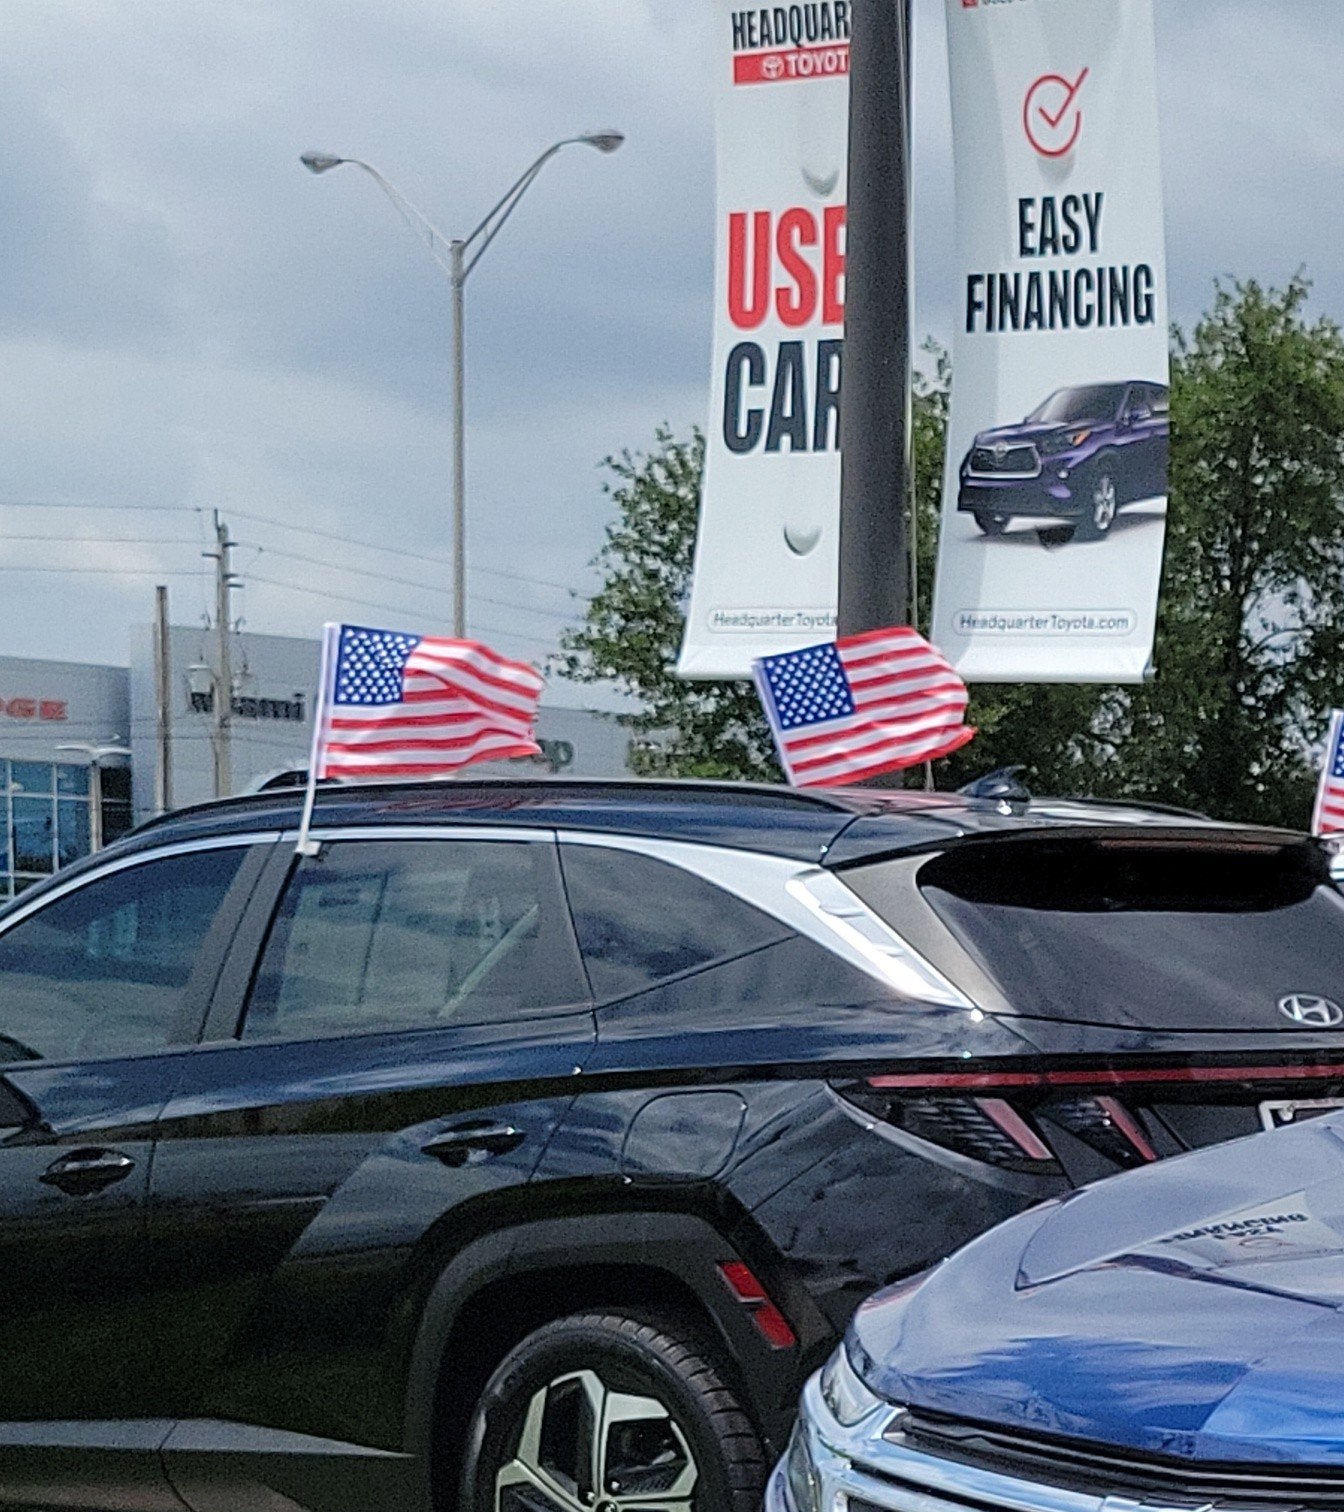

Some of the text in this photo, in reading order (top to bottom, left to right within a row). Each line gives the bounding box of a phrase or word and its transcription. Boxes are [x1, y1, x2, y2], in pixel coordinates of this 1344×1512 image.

[732, 1, 849, 50] HEADQUAR
[1018, 191, 1104, 258] EASY
[728, 204, 848, 331] USE
[966, 263, 1155, 333] FINANCING
[723, 339, 843, 454] CAR
[960, 613, 1130, 633] HeadquarterToyota.com
